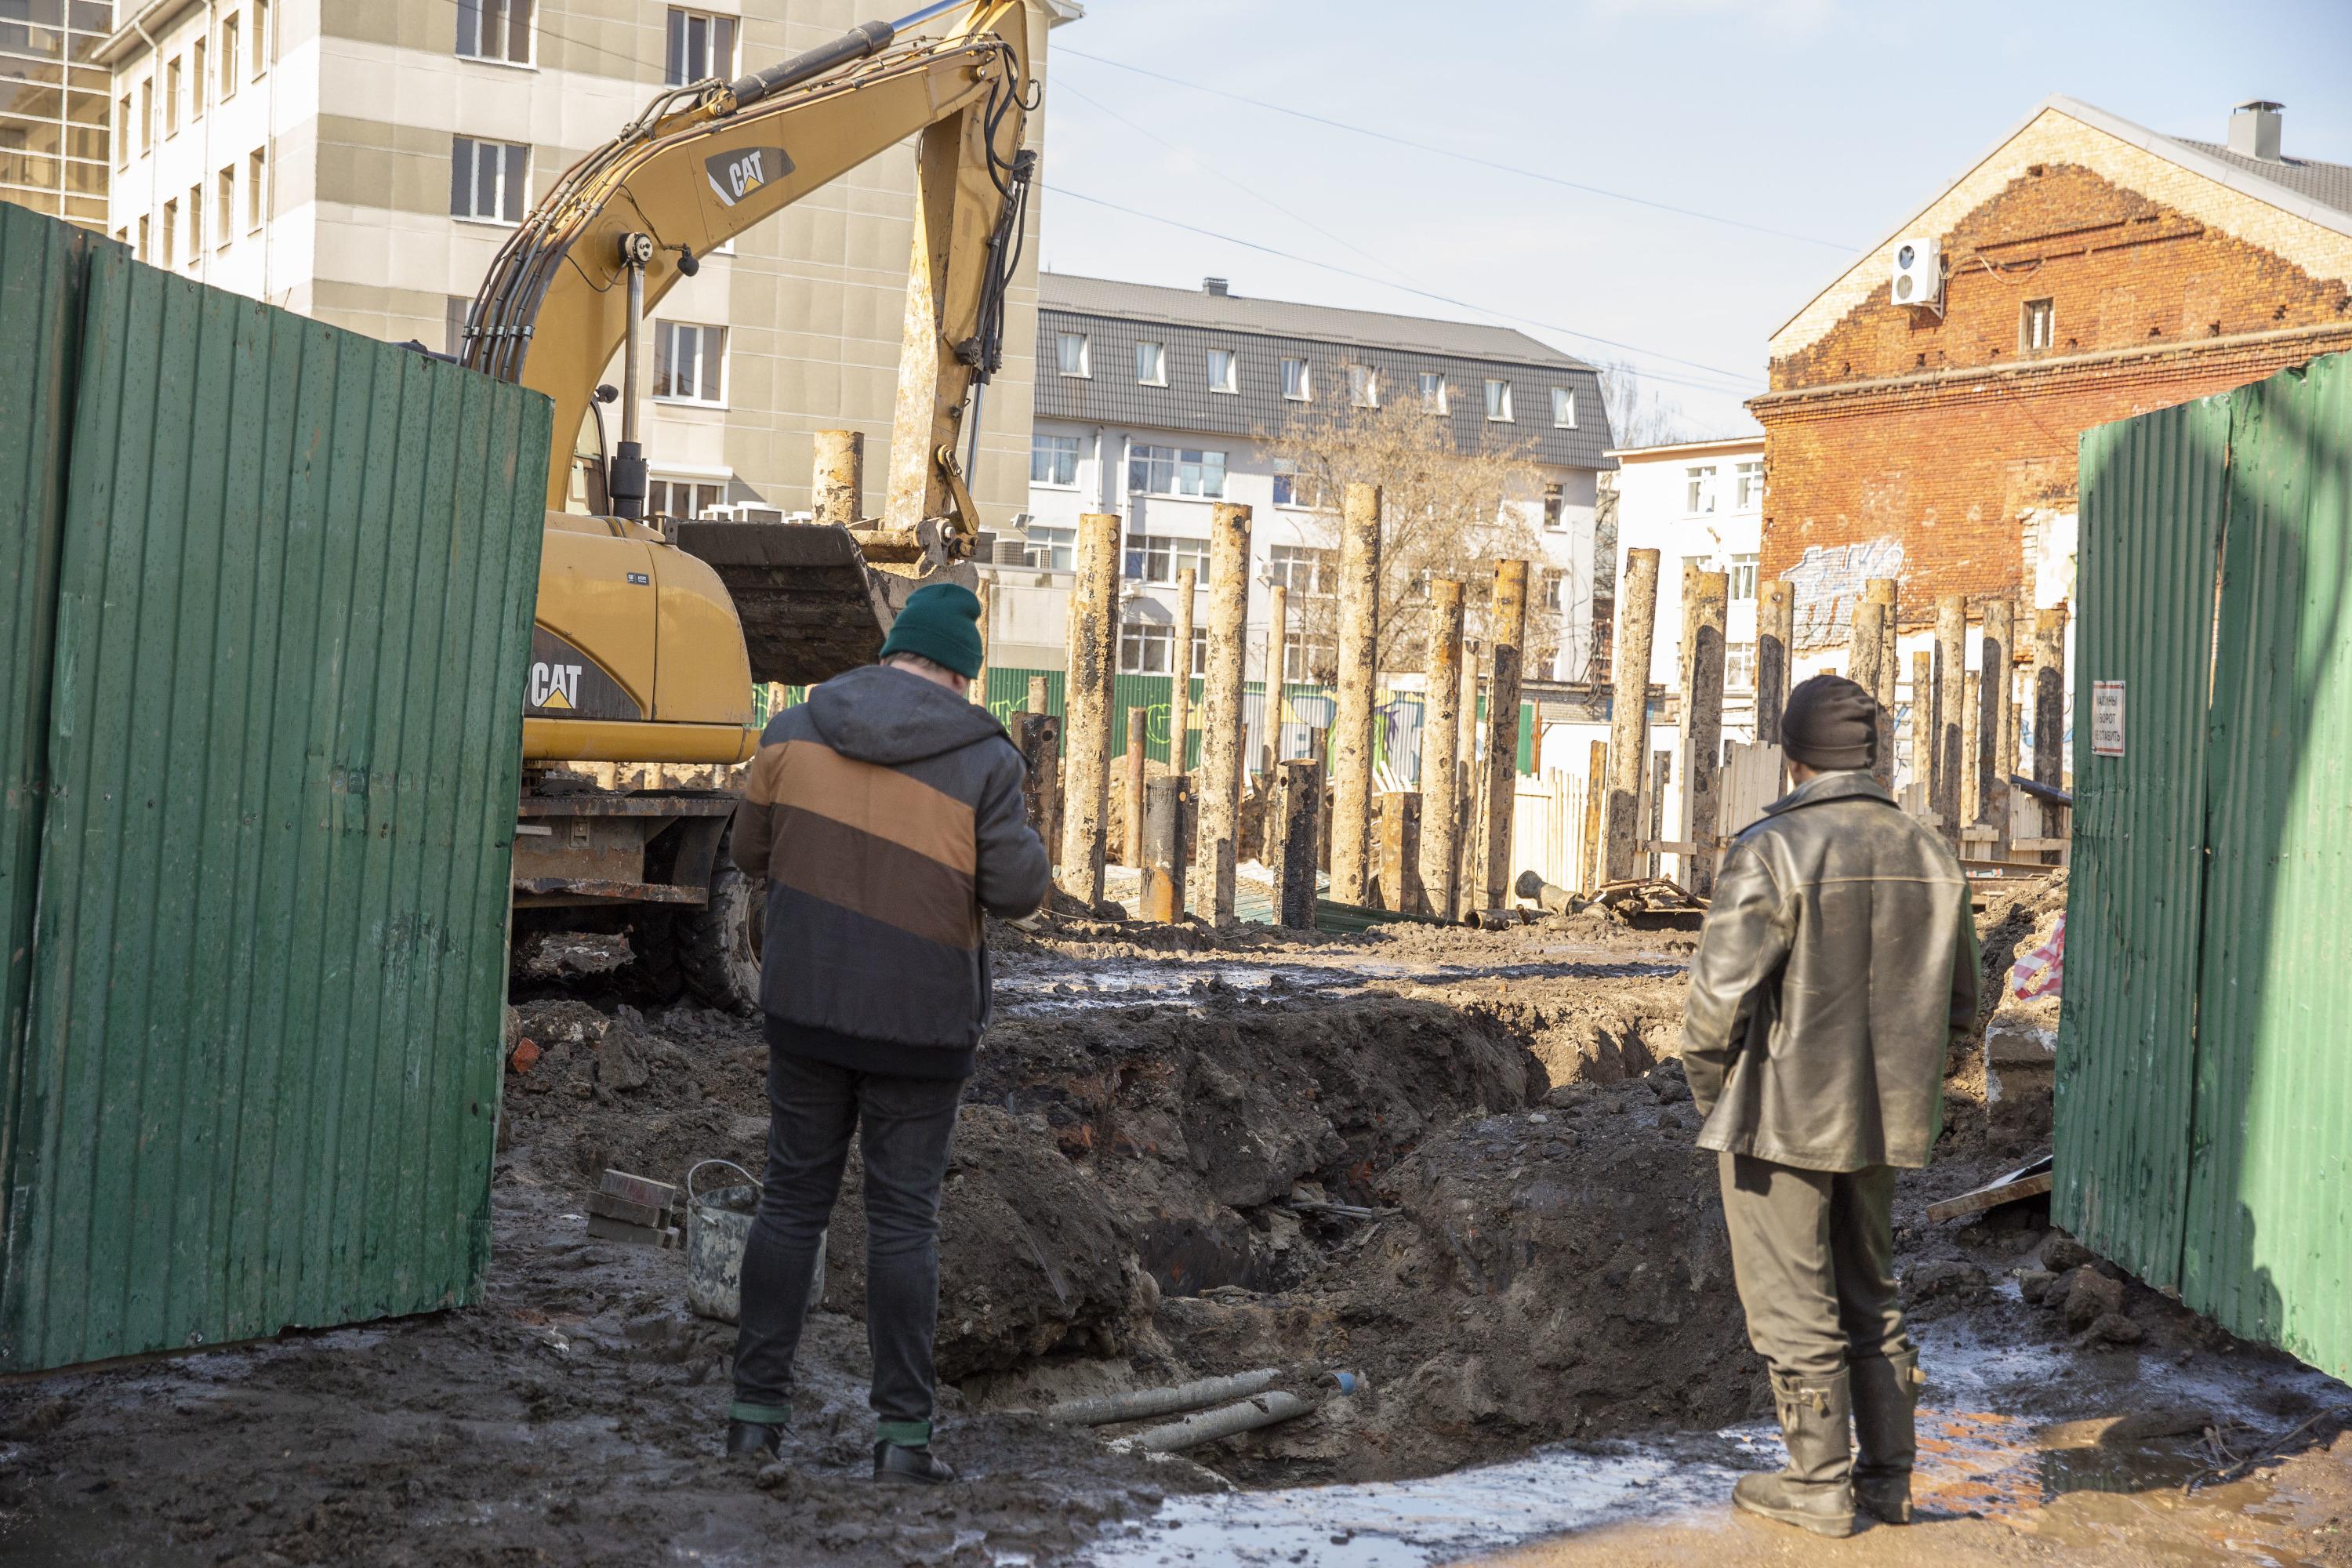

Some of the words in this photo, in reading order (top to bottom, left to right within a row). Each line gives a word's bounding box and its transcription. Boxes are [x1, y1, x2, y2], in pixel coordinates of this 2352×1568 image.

[729, 151, 764, 197] CAT
[532, 662, 582, 709] CAT
[2099, 713, 2116, 724] ВОРОТ
[2100, 730, 2121, 742] СТАВИТЬ
